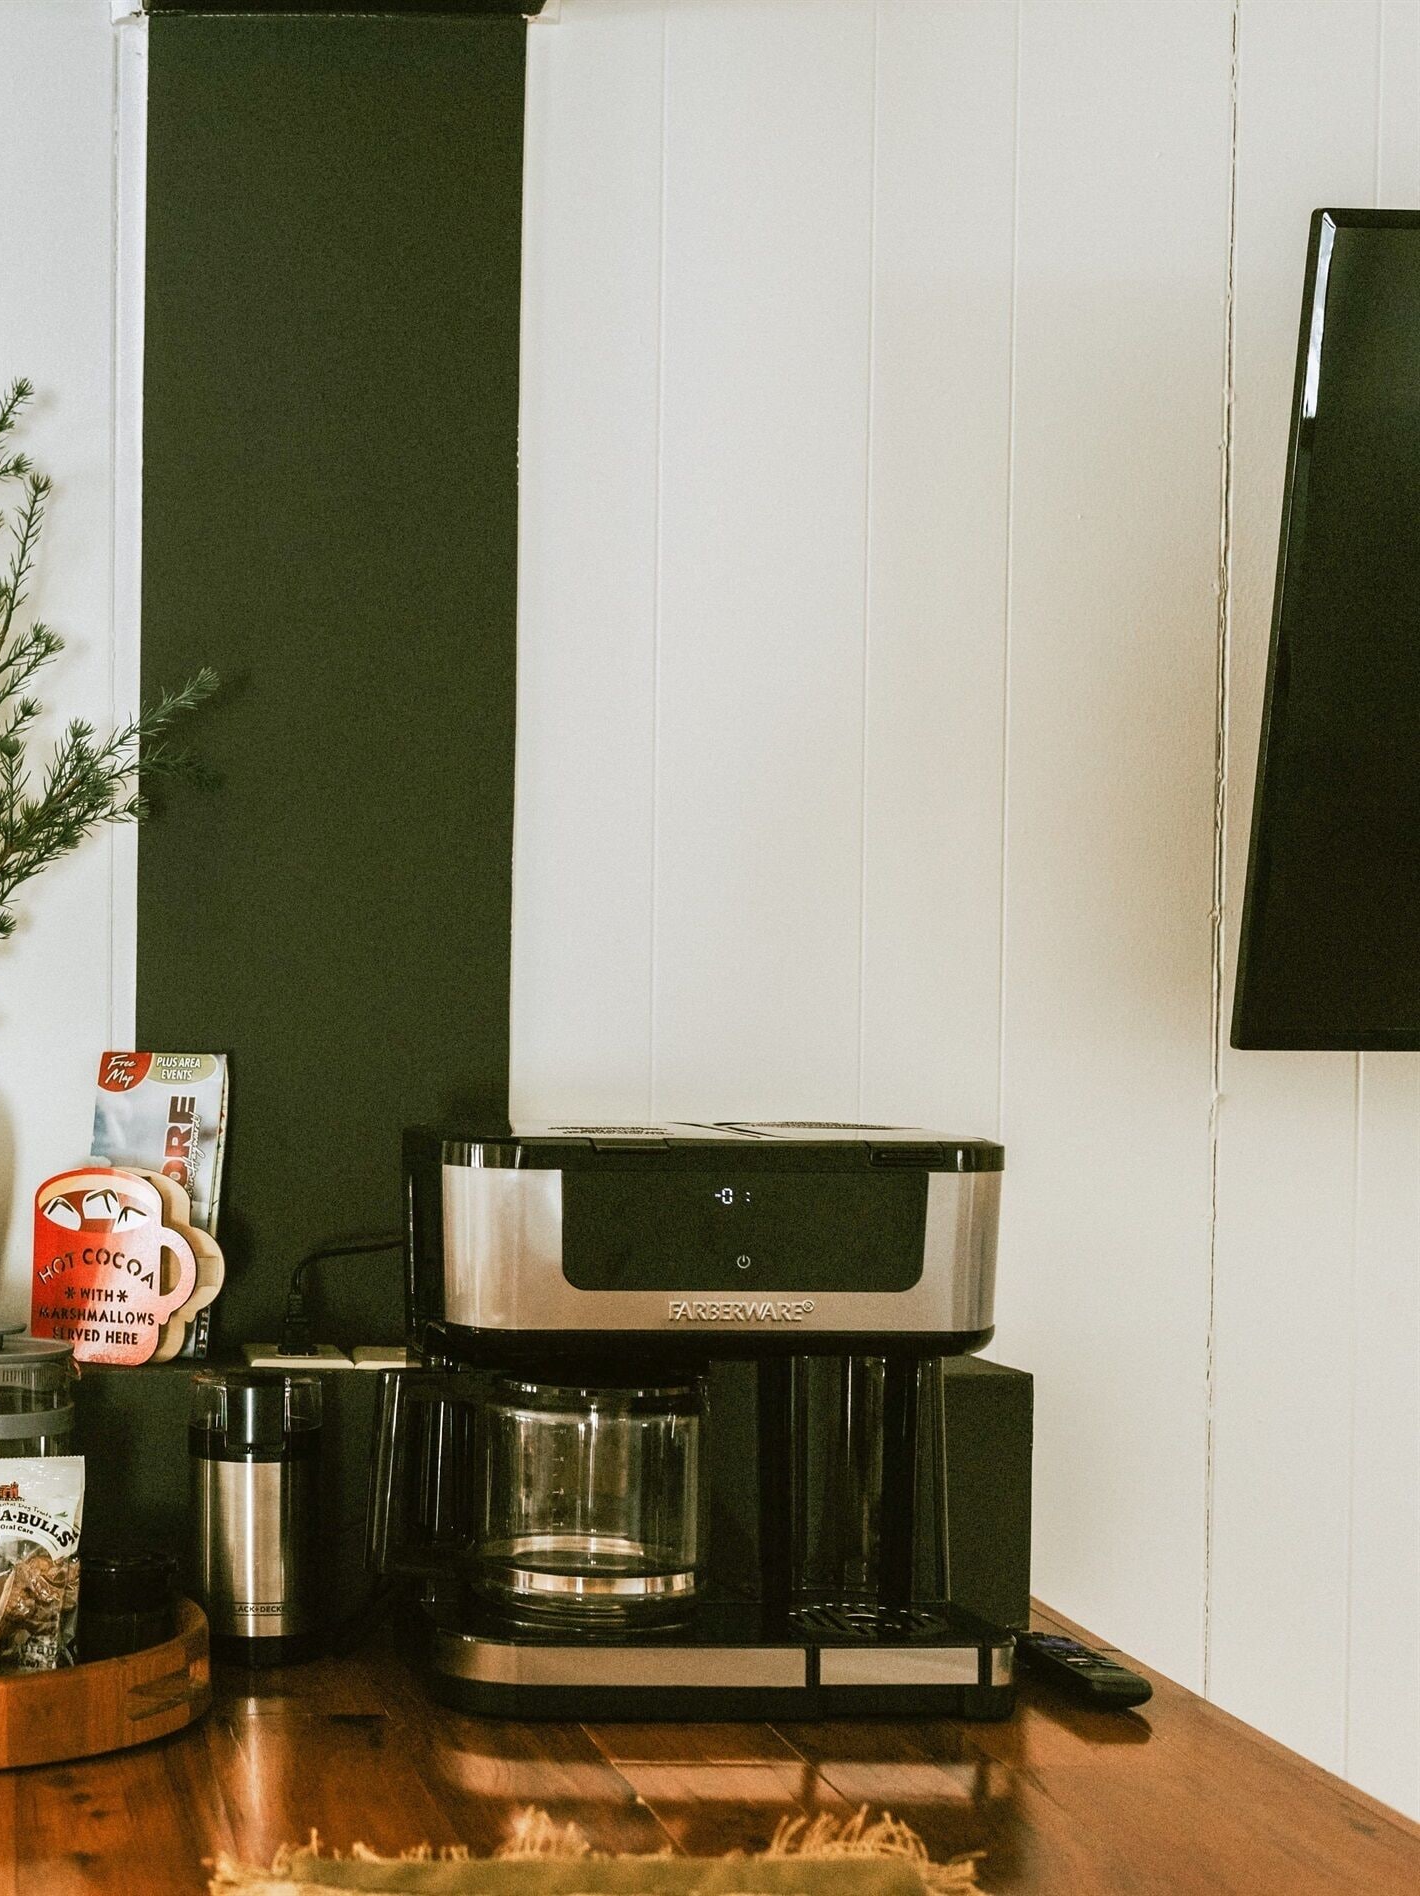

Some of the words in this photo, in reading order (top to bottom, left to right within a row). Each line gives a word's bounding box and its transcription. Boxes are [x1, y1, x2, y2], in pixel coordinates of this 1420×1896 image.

[107, 1053, 137, 1070] Free
[156, 1056, 179, 1068] PLUS
[179, 1057, 202, 1069] AREA
[105, 1068, 134, 1089] Map
[161, 1069, 193, 1081] EVENTS
[38, 1251, 76, 1285] HOT
[82, 1248, 155, 1290] COCOA
[80, 1287, 114, 1302] WITH
[40, 1306, 155, 1326] MARSHMALLOWS
[52, 1327, 100, 1342] SERVED
[105, 1330, 138, 1345] HERE
[0, 1523, 16, 1531] Oral
[17, 1525, 34, 1535] Care
